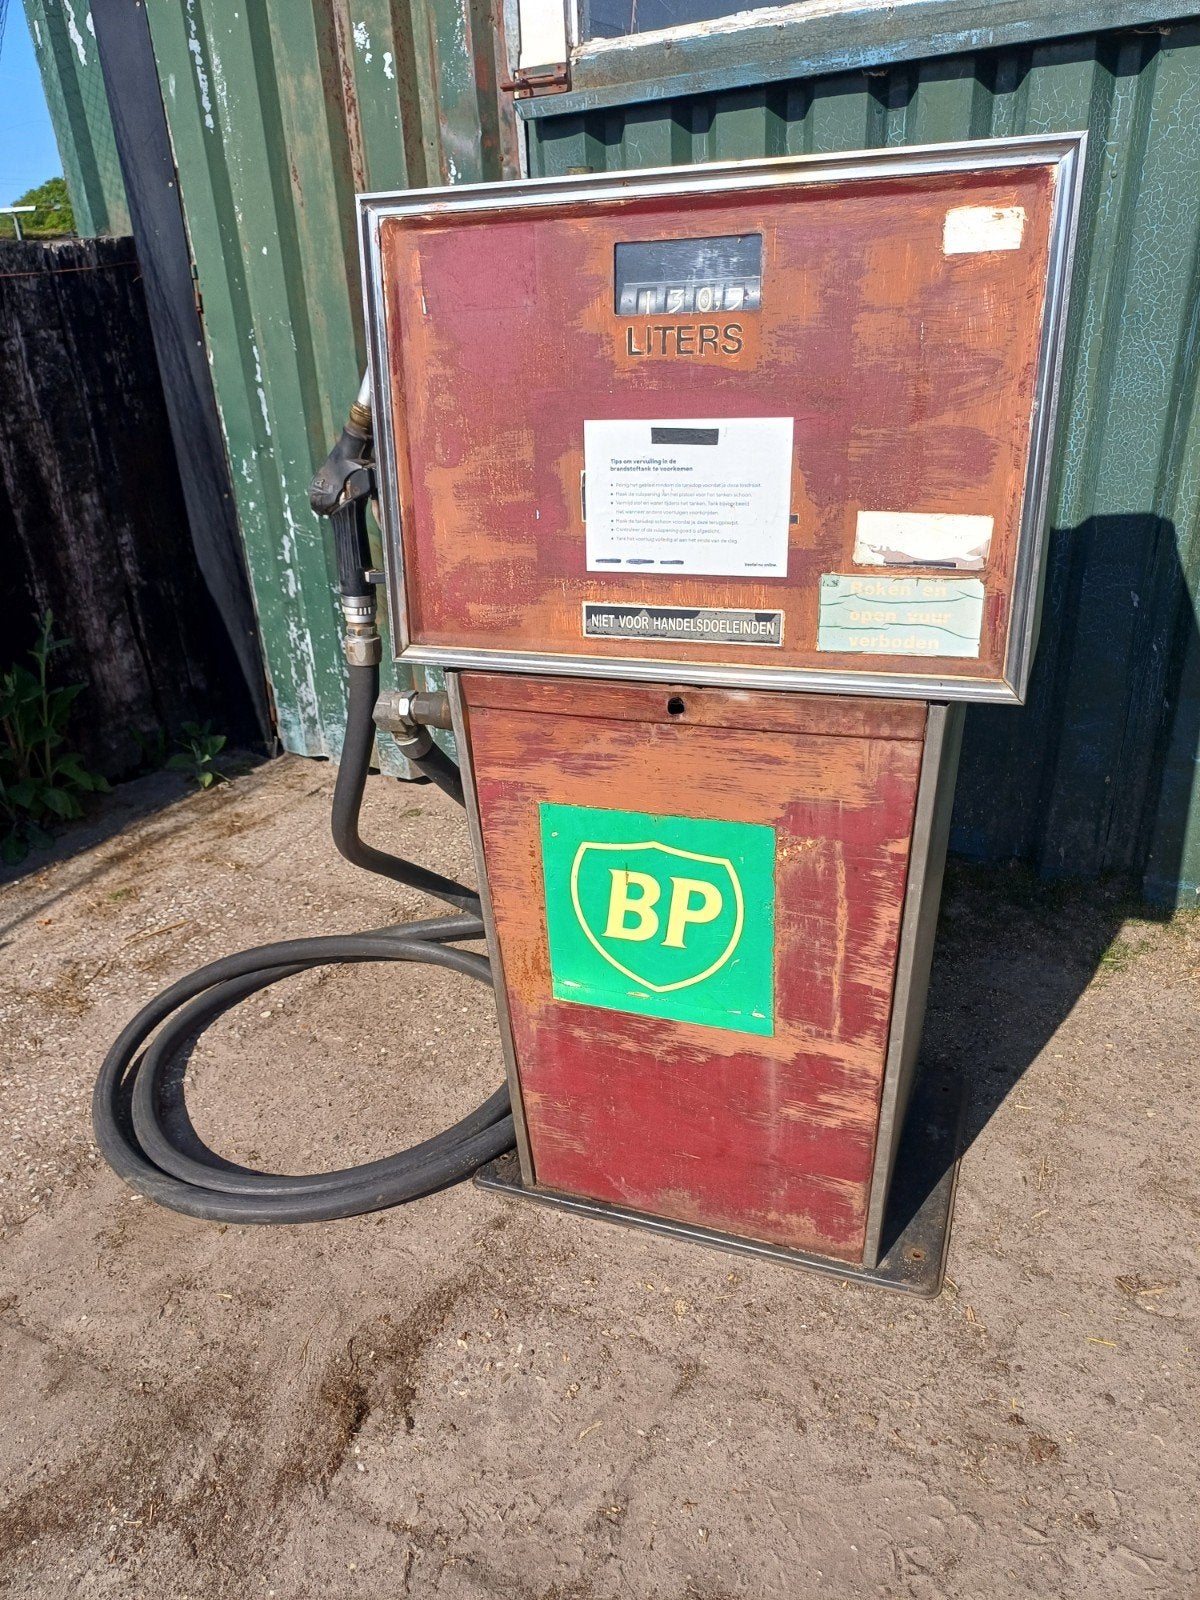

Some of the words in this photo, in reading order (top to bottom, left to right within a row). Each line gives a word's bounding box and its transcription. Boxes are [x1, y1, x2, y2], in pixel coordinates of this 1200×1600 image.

[626, 324, 743, 356] LITERS
[850, 581, 911, 597] Roken
[923, 585, 947, 598] en
[591, 614, 615, 628] NIET
[619, 615, 649, 629] VOOR
[653, 616, 775, 636] HANDELSDOELEINDEN
[849, 610, 897, 624] open
[907, 611, 952, 624] vuur
[849, 634, 939, 650] verboden
[601, 868, 723, 949] BP
